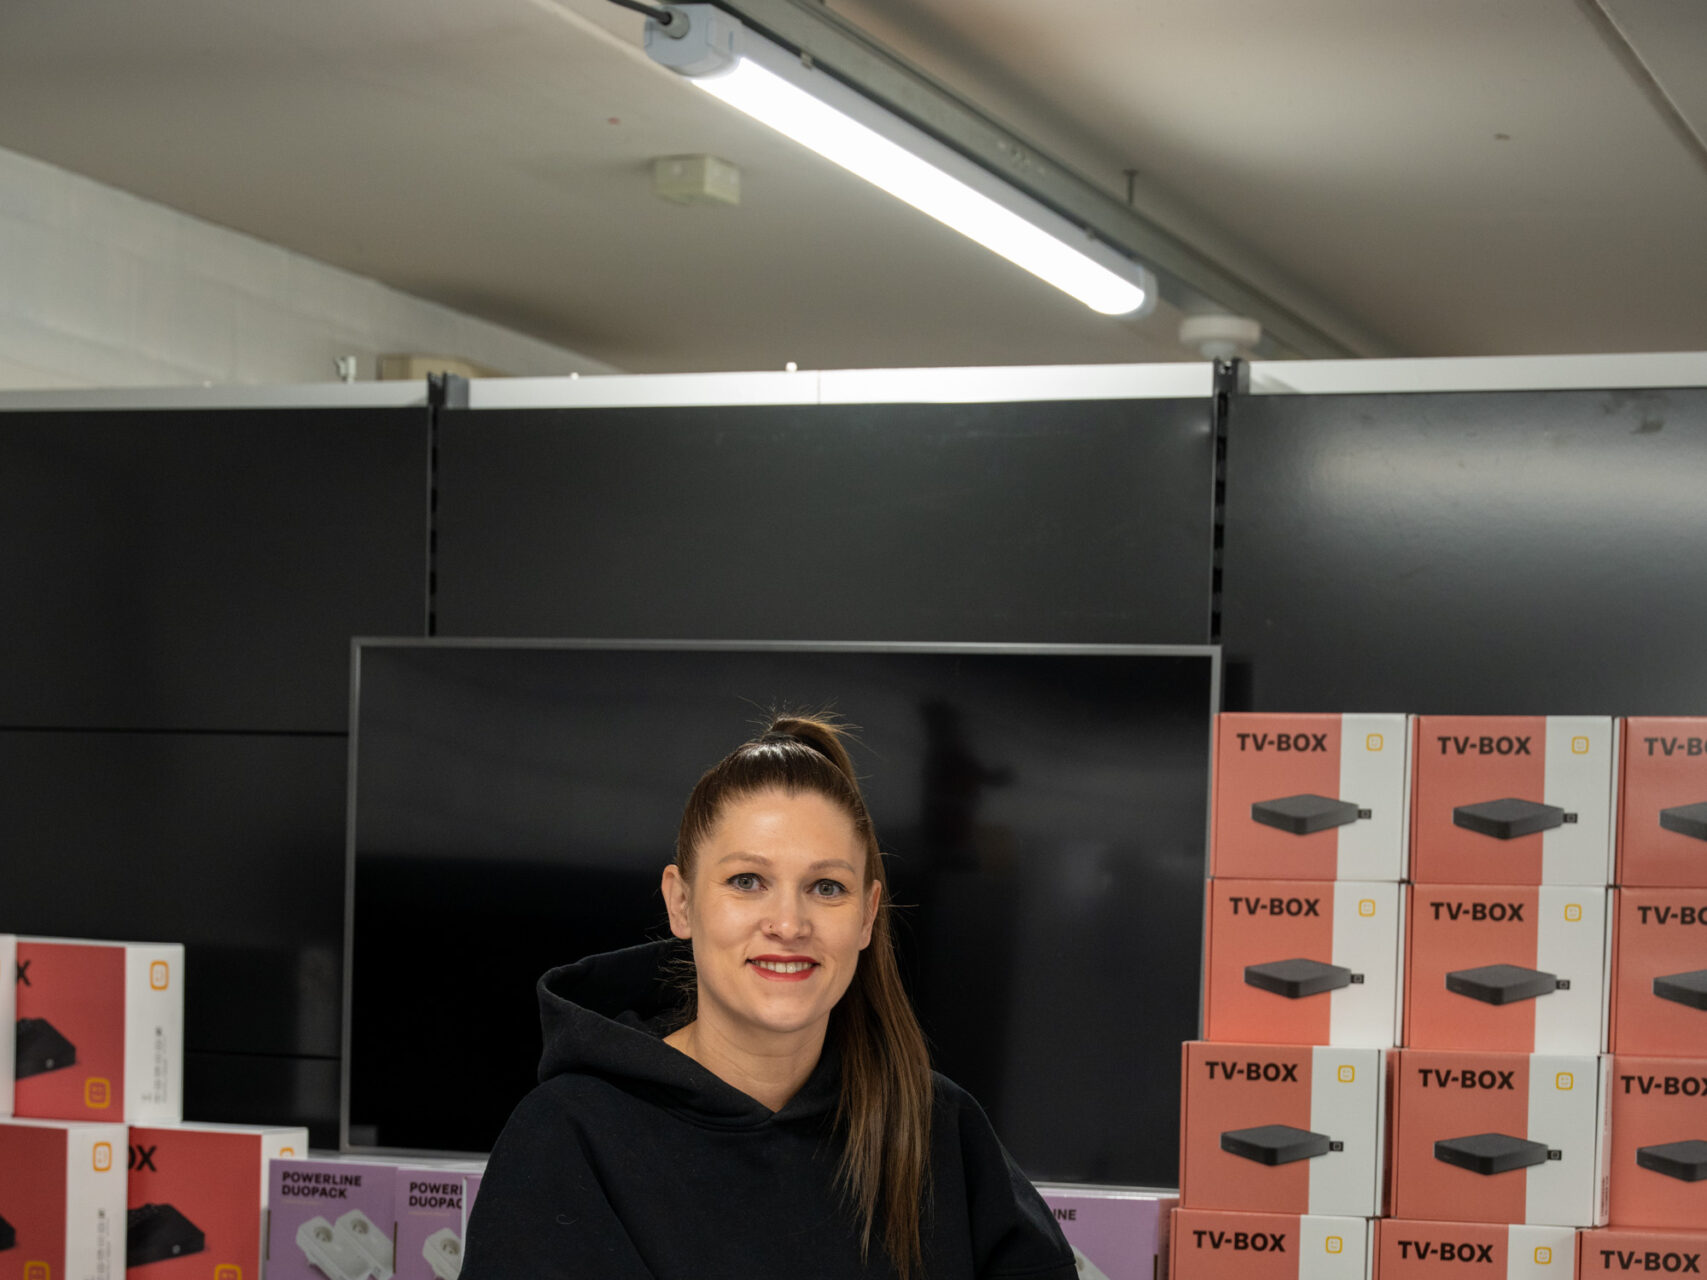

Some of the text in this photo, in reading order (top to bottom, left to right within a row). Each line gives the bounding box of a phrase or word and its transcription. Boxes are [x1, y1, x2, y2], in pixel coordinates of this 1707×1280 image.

[1236, 733, 1327, 752] TV-BOX
[1437, 736, 1531, 756] TV-BOX
[1643, 737, 1707, 757] TV-B
[1229, 897, 1320, 917] TV-BOX
[1430, 901, 1524, 922] TV-BOX
[1205, 1061, 1298, 1083] TV-BOX
[1418, 1068, 1515, 1090] TV-BOX
[281, 1171, 362, 1187] POWERLINE
[281, 1185, 347, 1199] DUOPACK
[1192, 1230, 1286, 1253] TV-BOX
[1397, 1240, 1493, 1264] TV-BOX
[1599, 1249, 1701, 1274] TV-BOX
